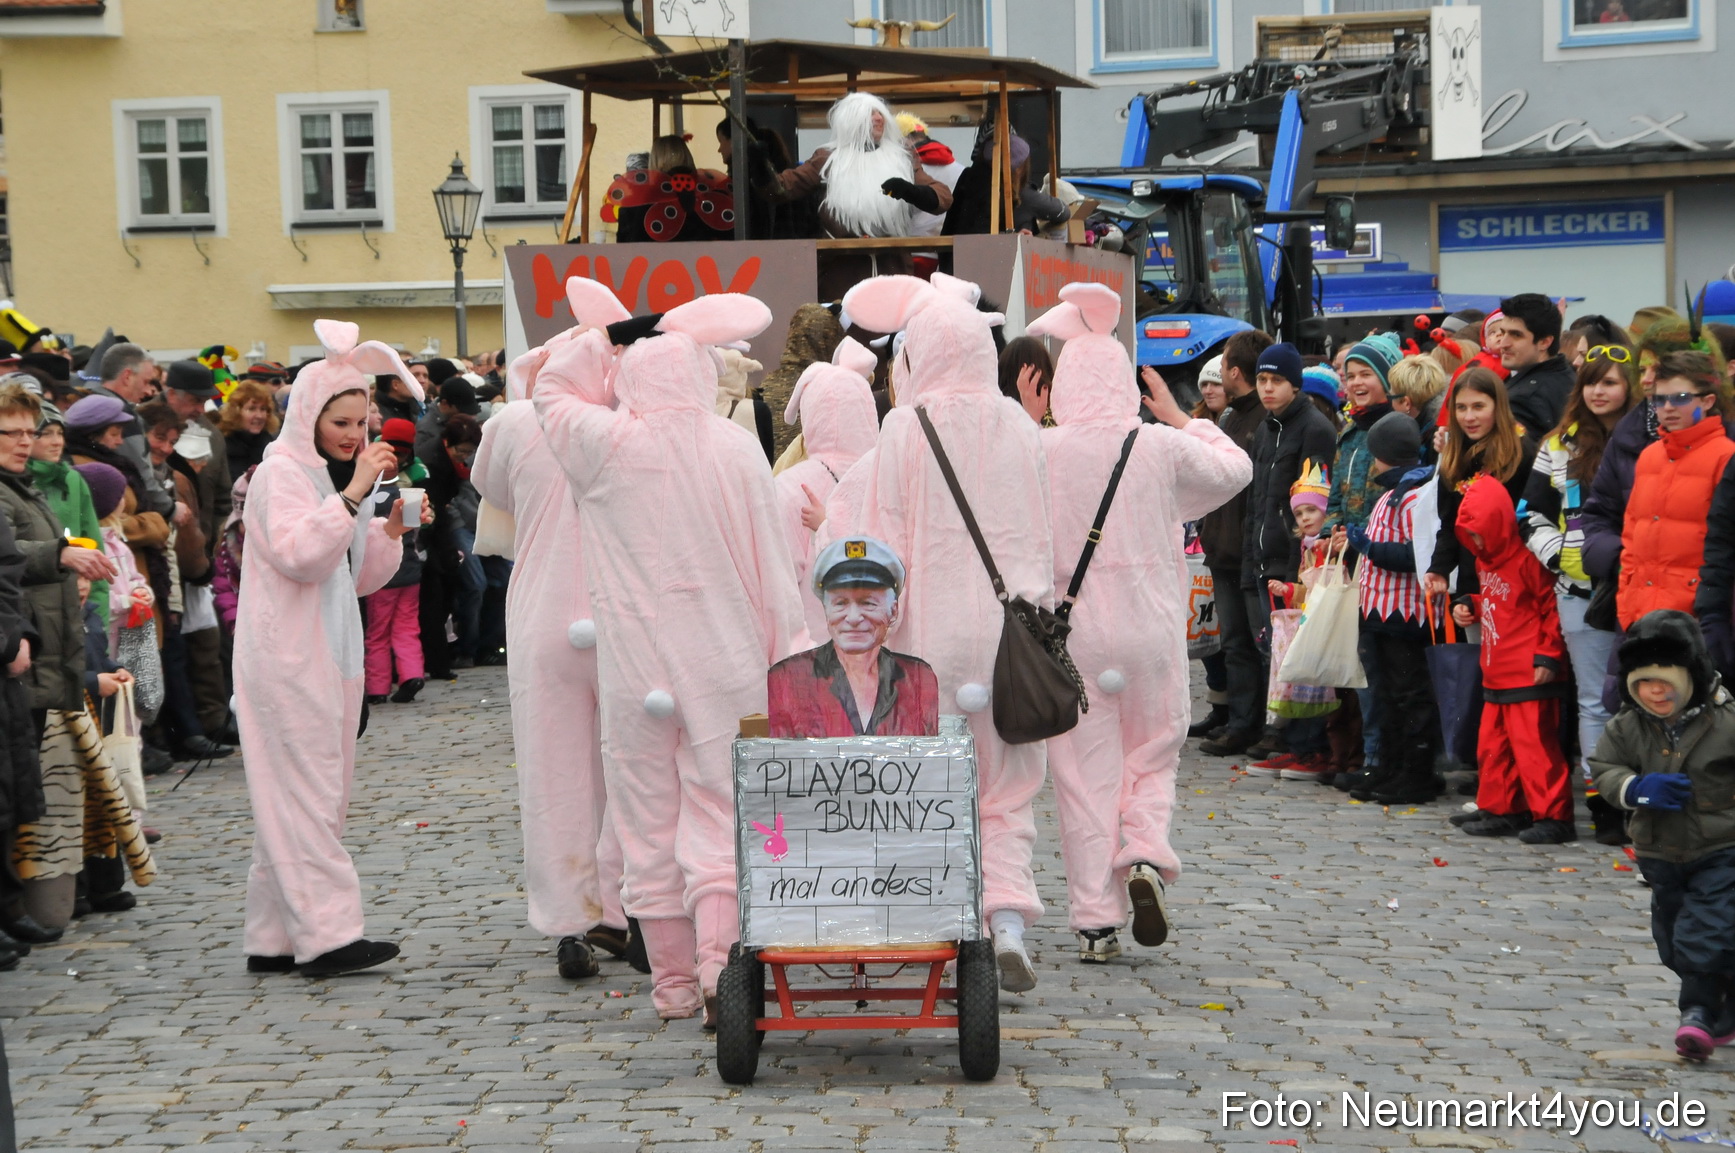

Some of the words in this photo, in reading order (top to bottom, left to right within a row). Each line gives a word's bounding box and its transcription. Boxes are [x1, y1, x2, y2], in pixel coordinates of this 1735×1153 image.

[1457, 210, 1650, 239] SCHLECKER
[756, 758, 922, 798] PLAYBOY
[814, 799, 956, 834] BUNNYS
[769, 865, 823, 901] mal
[831, 863, 950, 900] anders!
